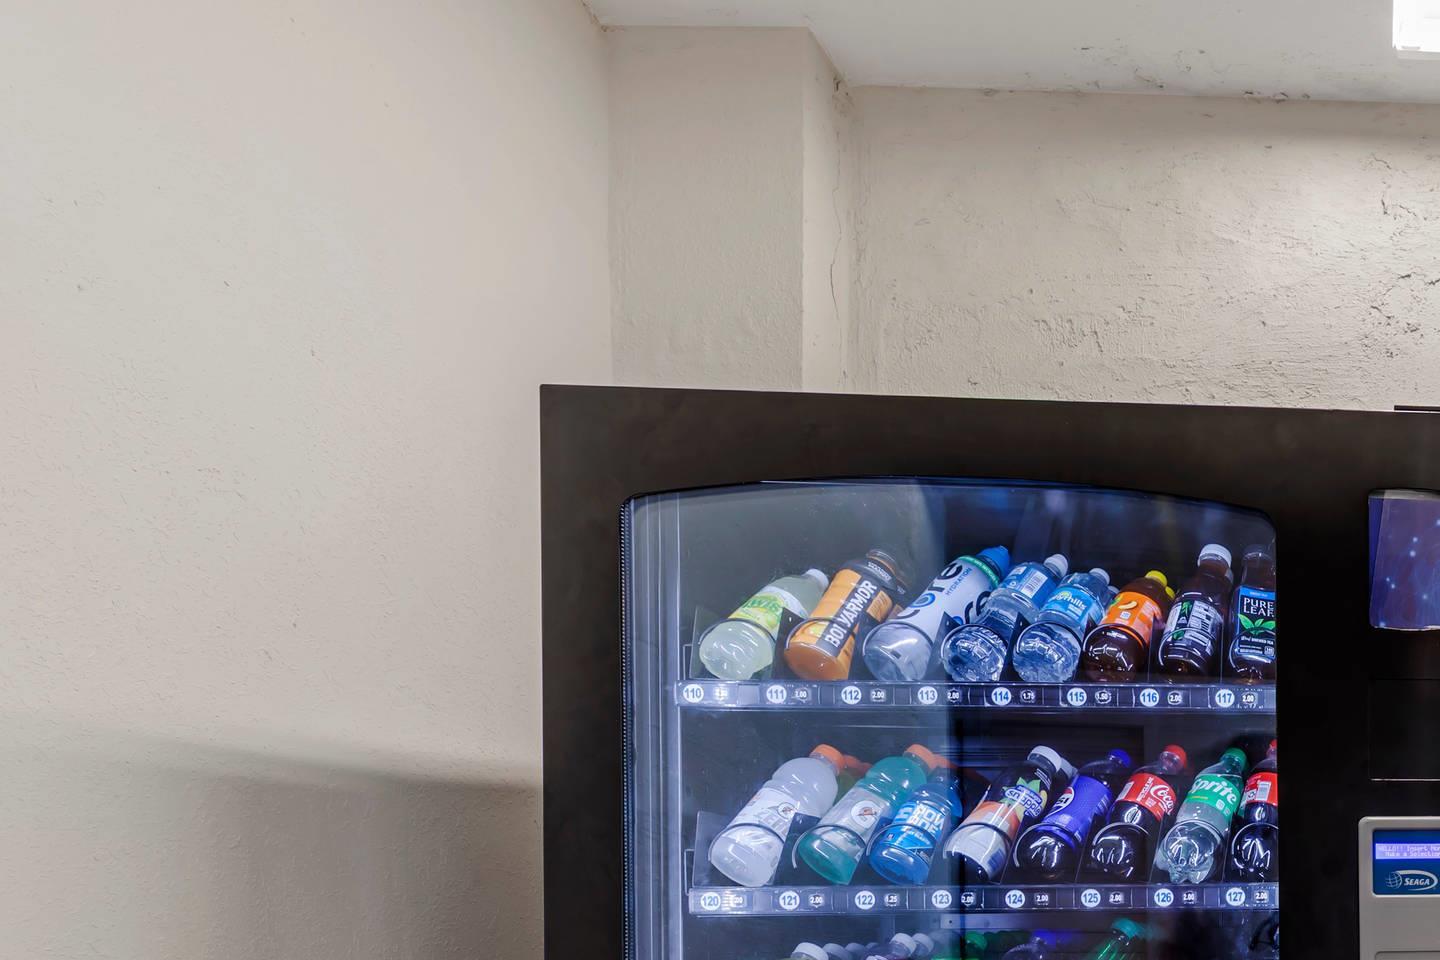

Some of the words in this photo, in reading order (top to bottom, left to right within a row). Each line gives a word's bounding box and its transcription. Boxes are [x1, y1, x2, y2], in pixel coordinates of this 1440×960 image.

[1243, 597, 1274, 609] PURE
[684, 688, 702, 699] 110
[768, 688, 785, 699] 111
[842, 689, 860, 700] 112
[919, 690, 937, 701] 113
[993, 690, 1009, 701] 114
[1068, 691, 1085, 702] 115
[1141, 692, 1158, 703] 116
[1216, 692, 1233, 703] 117
[1404, 877, 1430, 886] SEAGA
[702, 895, 720, 907] 120
[781, 895, 798, 907] 121
[856, 894, 874, 906] 122
[933, 893, 951, 905] 123
[1007, 894, 1024, 904] 124
[1082, 893, 1099, 903] 125
[1156, 893, 1173, 902] 126
[1227, 892, 1244, 902] 127
